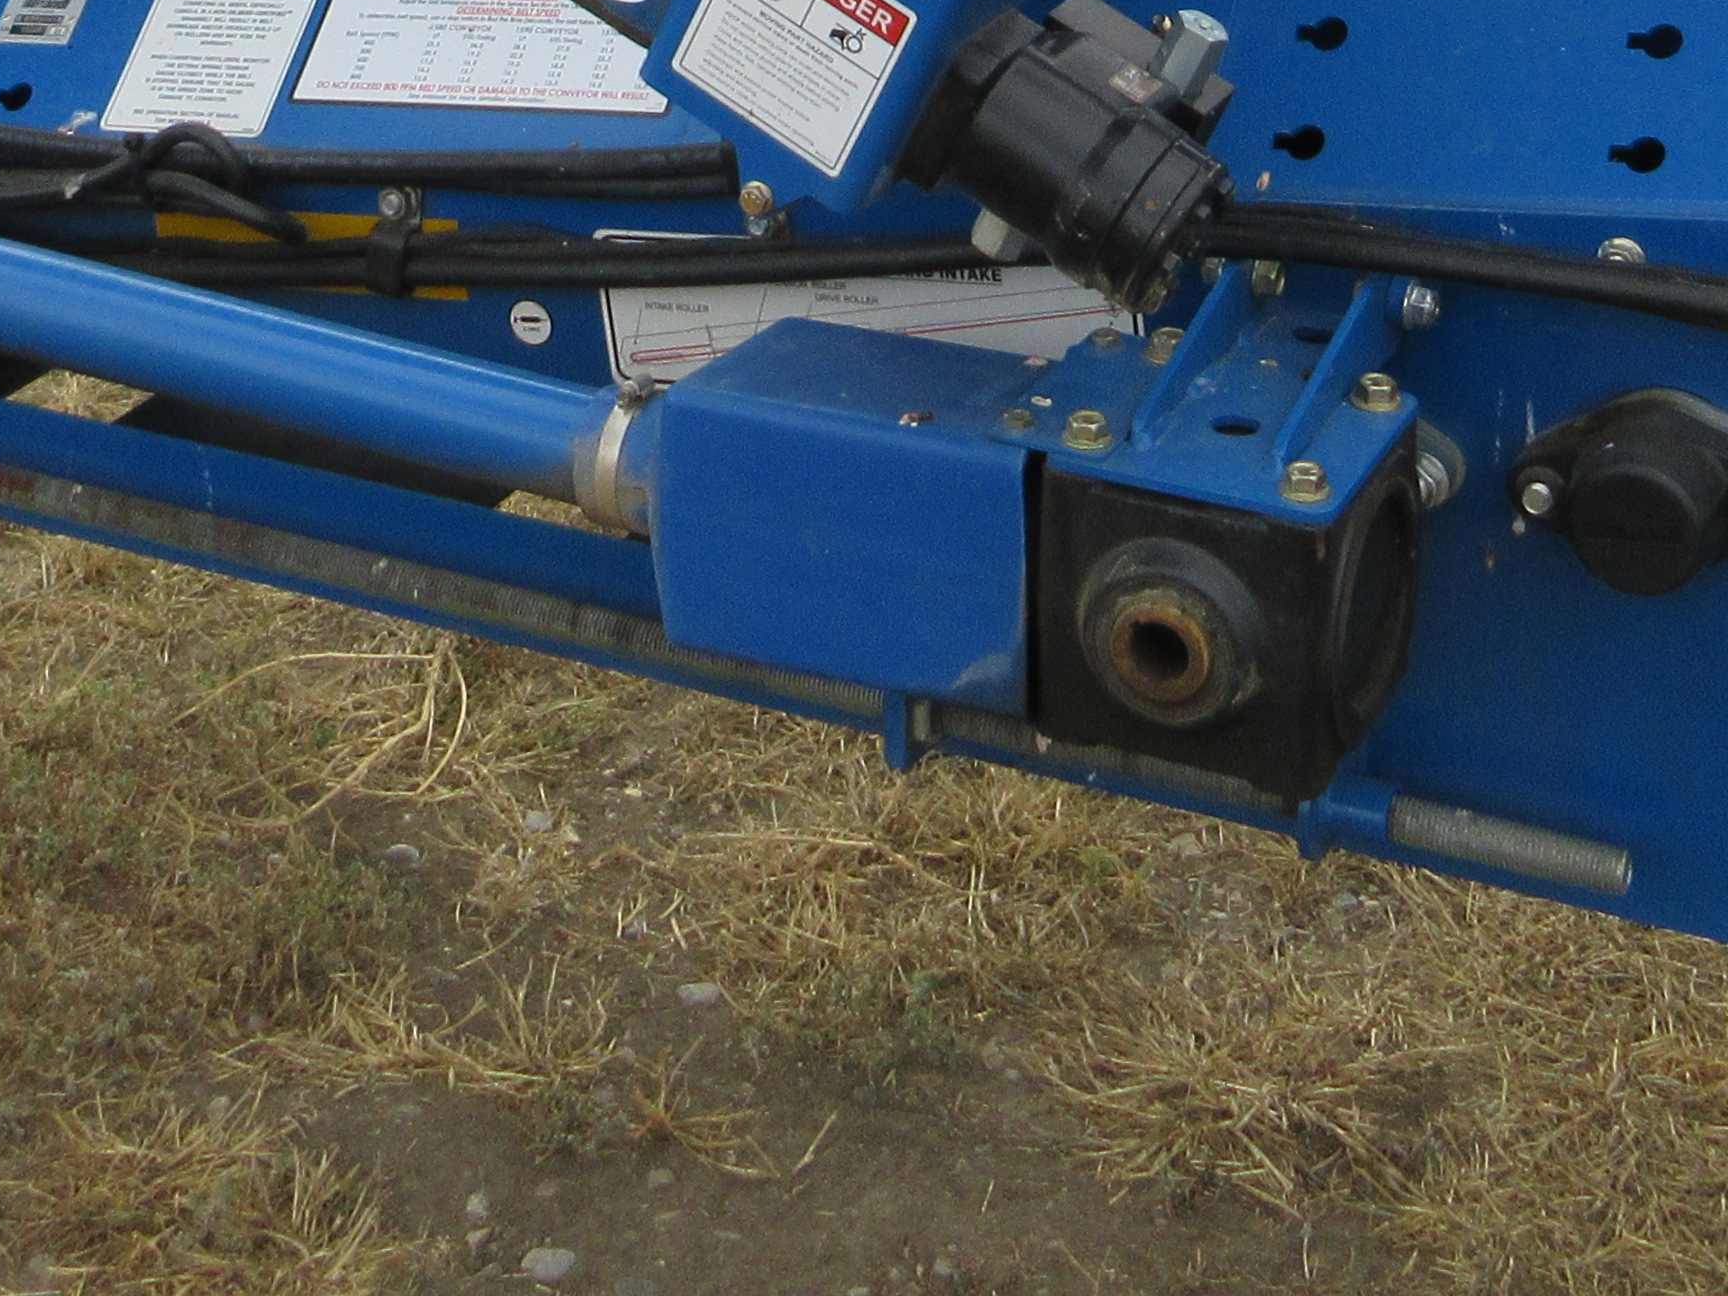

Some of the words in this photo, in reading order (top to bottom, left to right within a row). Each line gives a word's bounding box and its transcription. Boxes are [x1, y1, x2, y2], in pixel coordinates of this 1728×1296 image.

[535, 27, 579, 35] CONVEYOR
[759, 10, 786, 32] MOVING
[787, 29, 805, 43] PART
[806, 40, 835, 64] HAZARD
[316, 80, 330, 89] DO
[331, 81, 349, 89] NOT
[350, 82, 381, 90] EXCEED
[419, 84, 436, 92] BELT
[437, 84, 462, 93] SPEED
[463, 85, 475, 94] OR
[478, 86, 518, 95] DAMAGE
[520, 87, 531, 95] TO
[532, 88, 547, 96] THE
[548, 89, 599, 98] CONVEYOR
[601, 91, 619, 99] WILL
[622, 91, 649, 100] RESULT
[939, 267, 1003, 282] INTAKE
